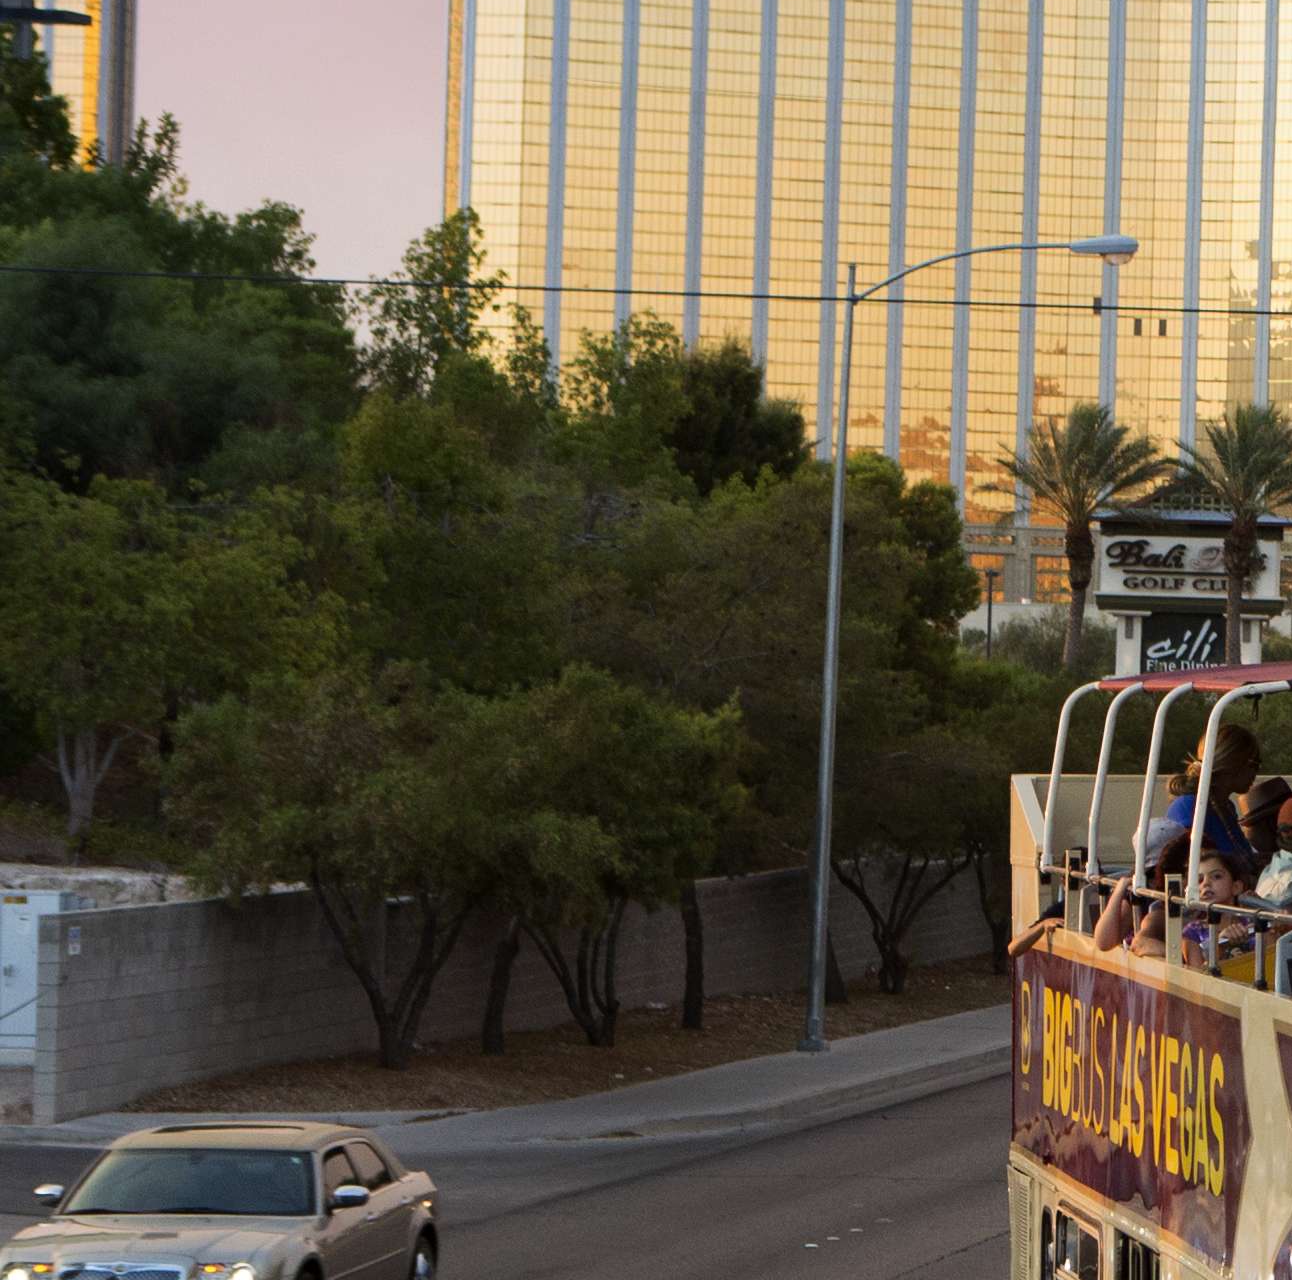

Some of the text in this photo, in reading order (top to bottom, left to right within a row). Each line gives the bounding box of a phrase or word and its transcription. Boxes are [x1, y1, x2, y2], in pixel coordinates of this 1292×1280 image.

[1106, 539, 1187, 569] Bali
[1123, 576, 1186, 591] GOLF
[1109, 1013, 1146, 1158] LAS
[1151, 1031, 1225, 1197] VEGAS
